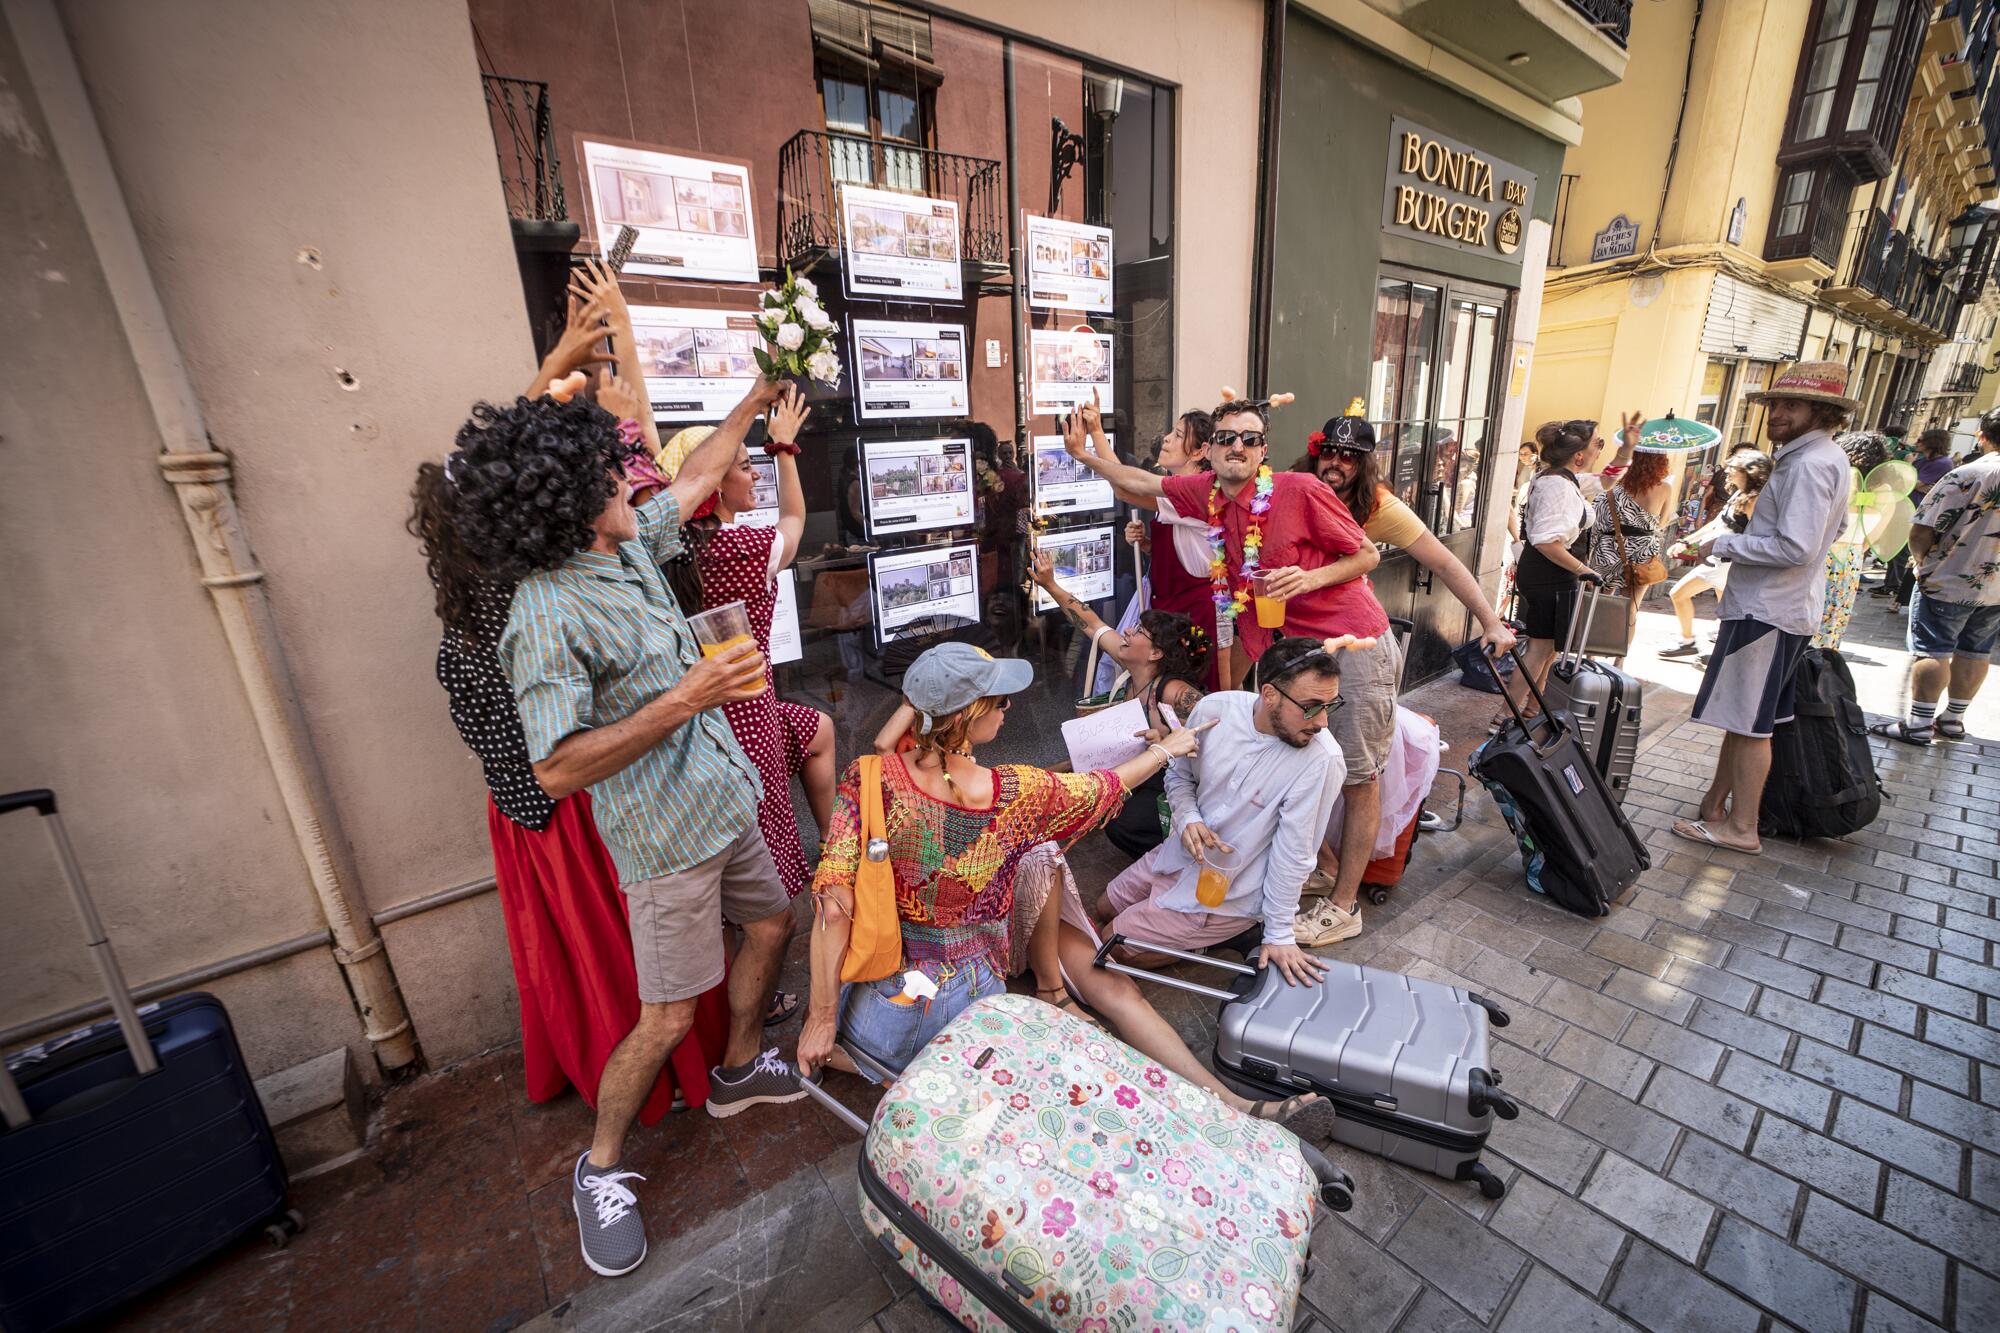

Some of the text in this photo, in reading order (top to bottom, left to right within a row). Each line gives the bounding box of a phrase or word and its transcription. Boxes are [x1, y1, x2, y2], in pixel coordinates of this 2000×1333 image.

[1401, 132, 1494, 202] BONITA
[1504, 179, 1528, 206] BAR
[1396, 185, 1490, 246] BURGER
[1600, 231, 1632, 244] COCHES
[1596, 246, 1608, 258] SAN
